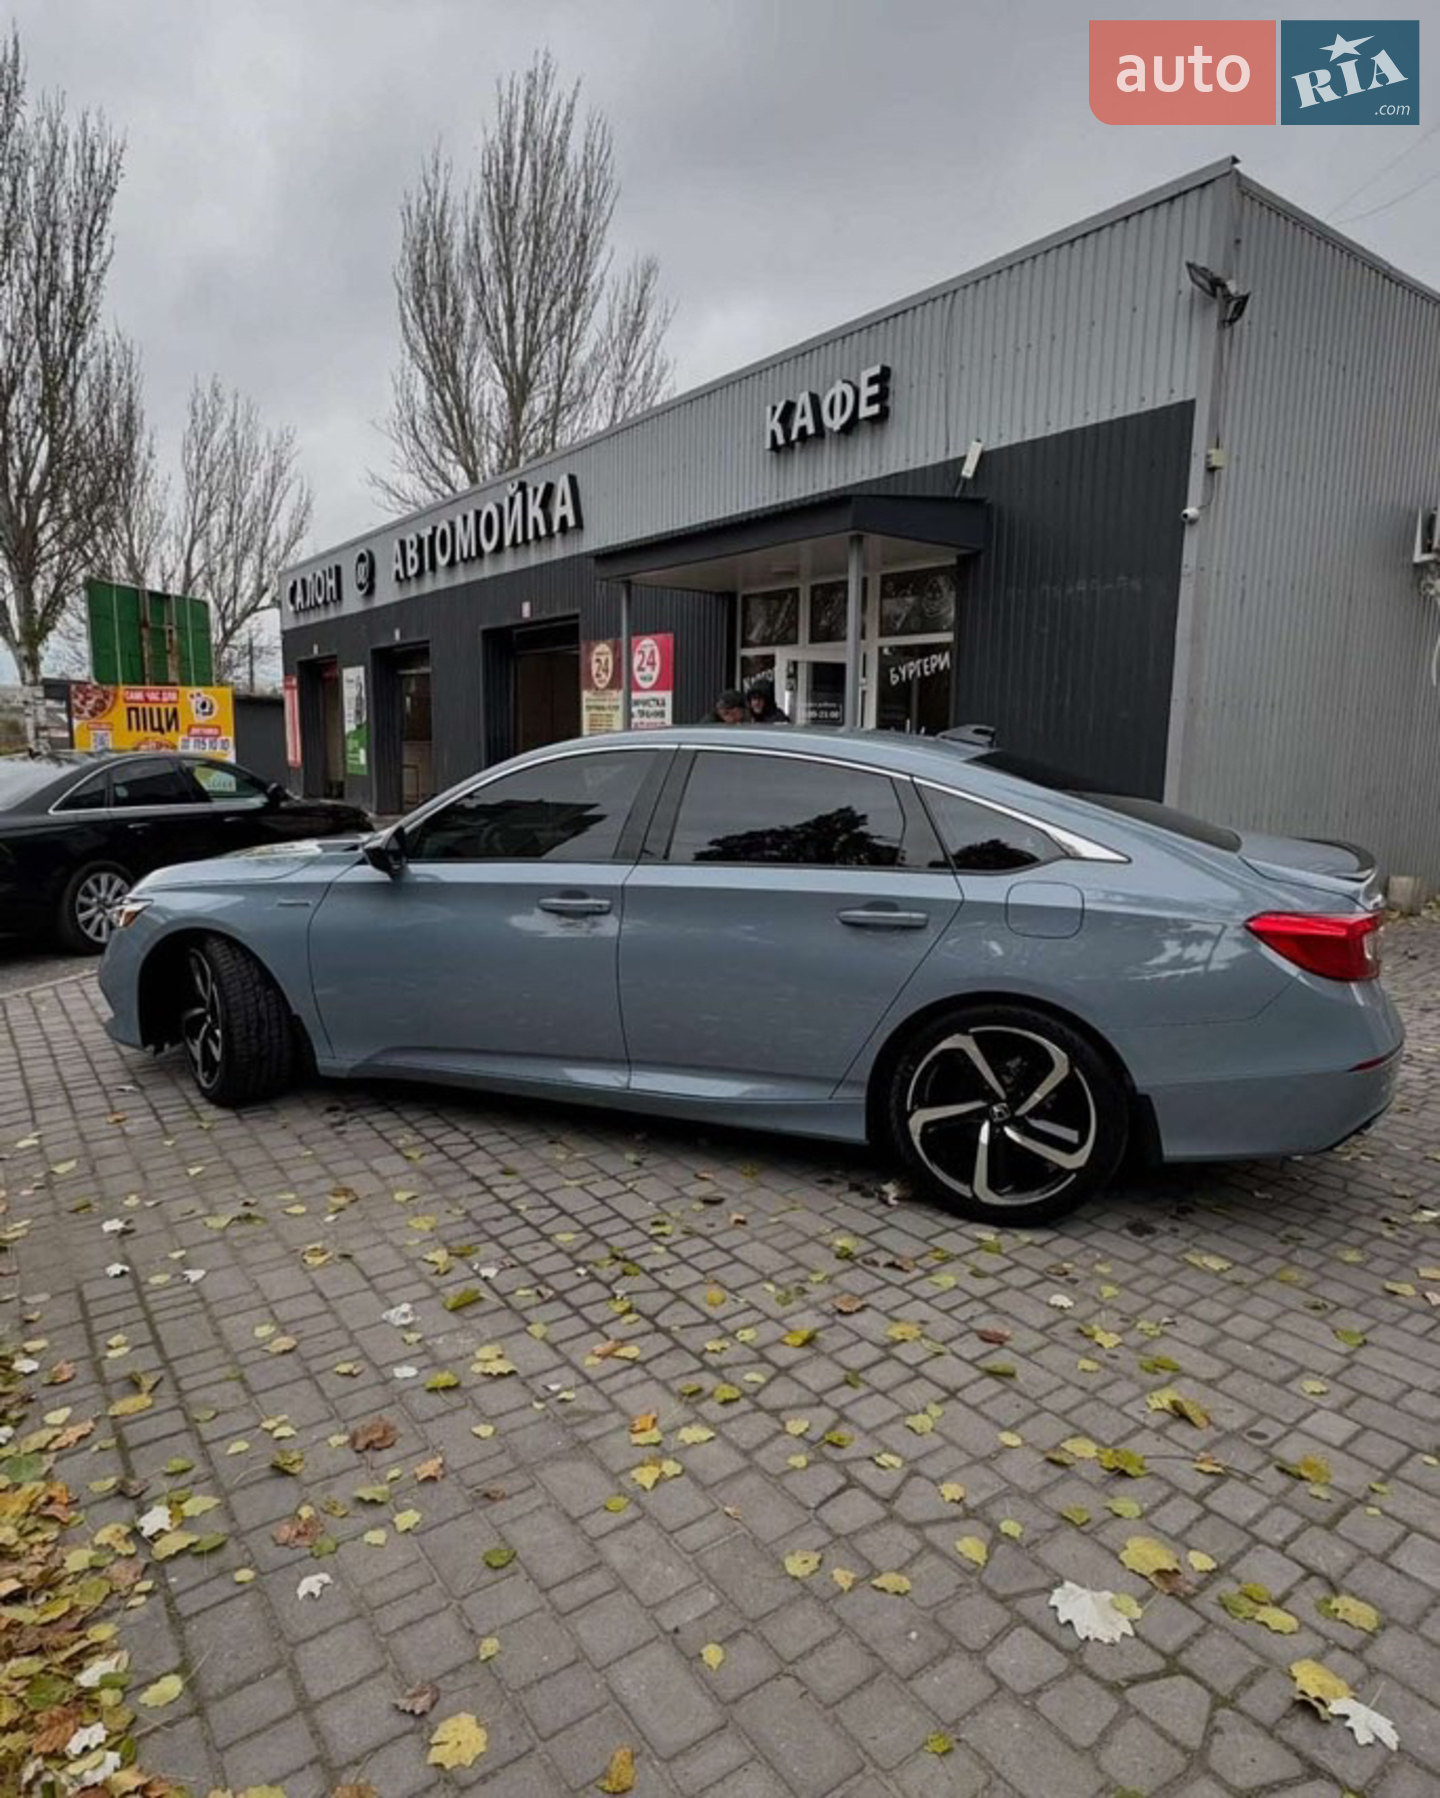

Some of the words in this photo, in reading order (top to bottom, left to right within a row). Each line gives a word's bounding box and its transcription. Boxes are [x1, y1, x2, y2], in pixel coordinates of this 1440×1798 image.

[765, 364, 889, 450] КАФЕ
[393, 473, 583, 582] АВТОМОЙКА
[595, 657, 609, 679] 24
[636, 648, 657, 673] 24
[889, 651, 951, 686] БУРГЕРИ
[127, 706, 180, 735] ПІЦИ
